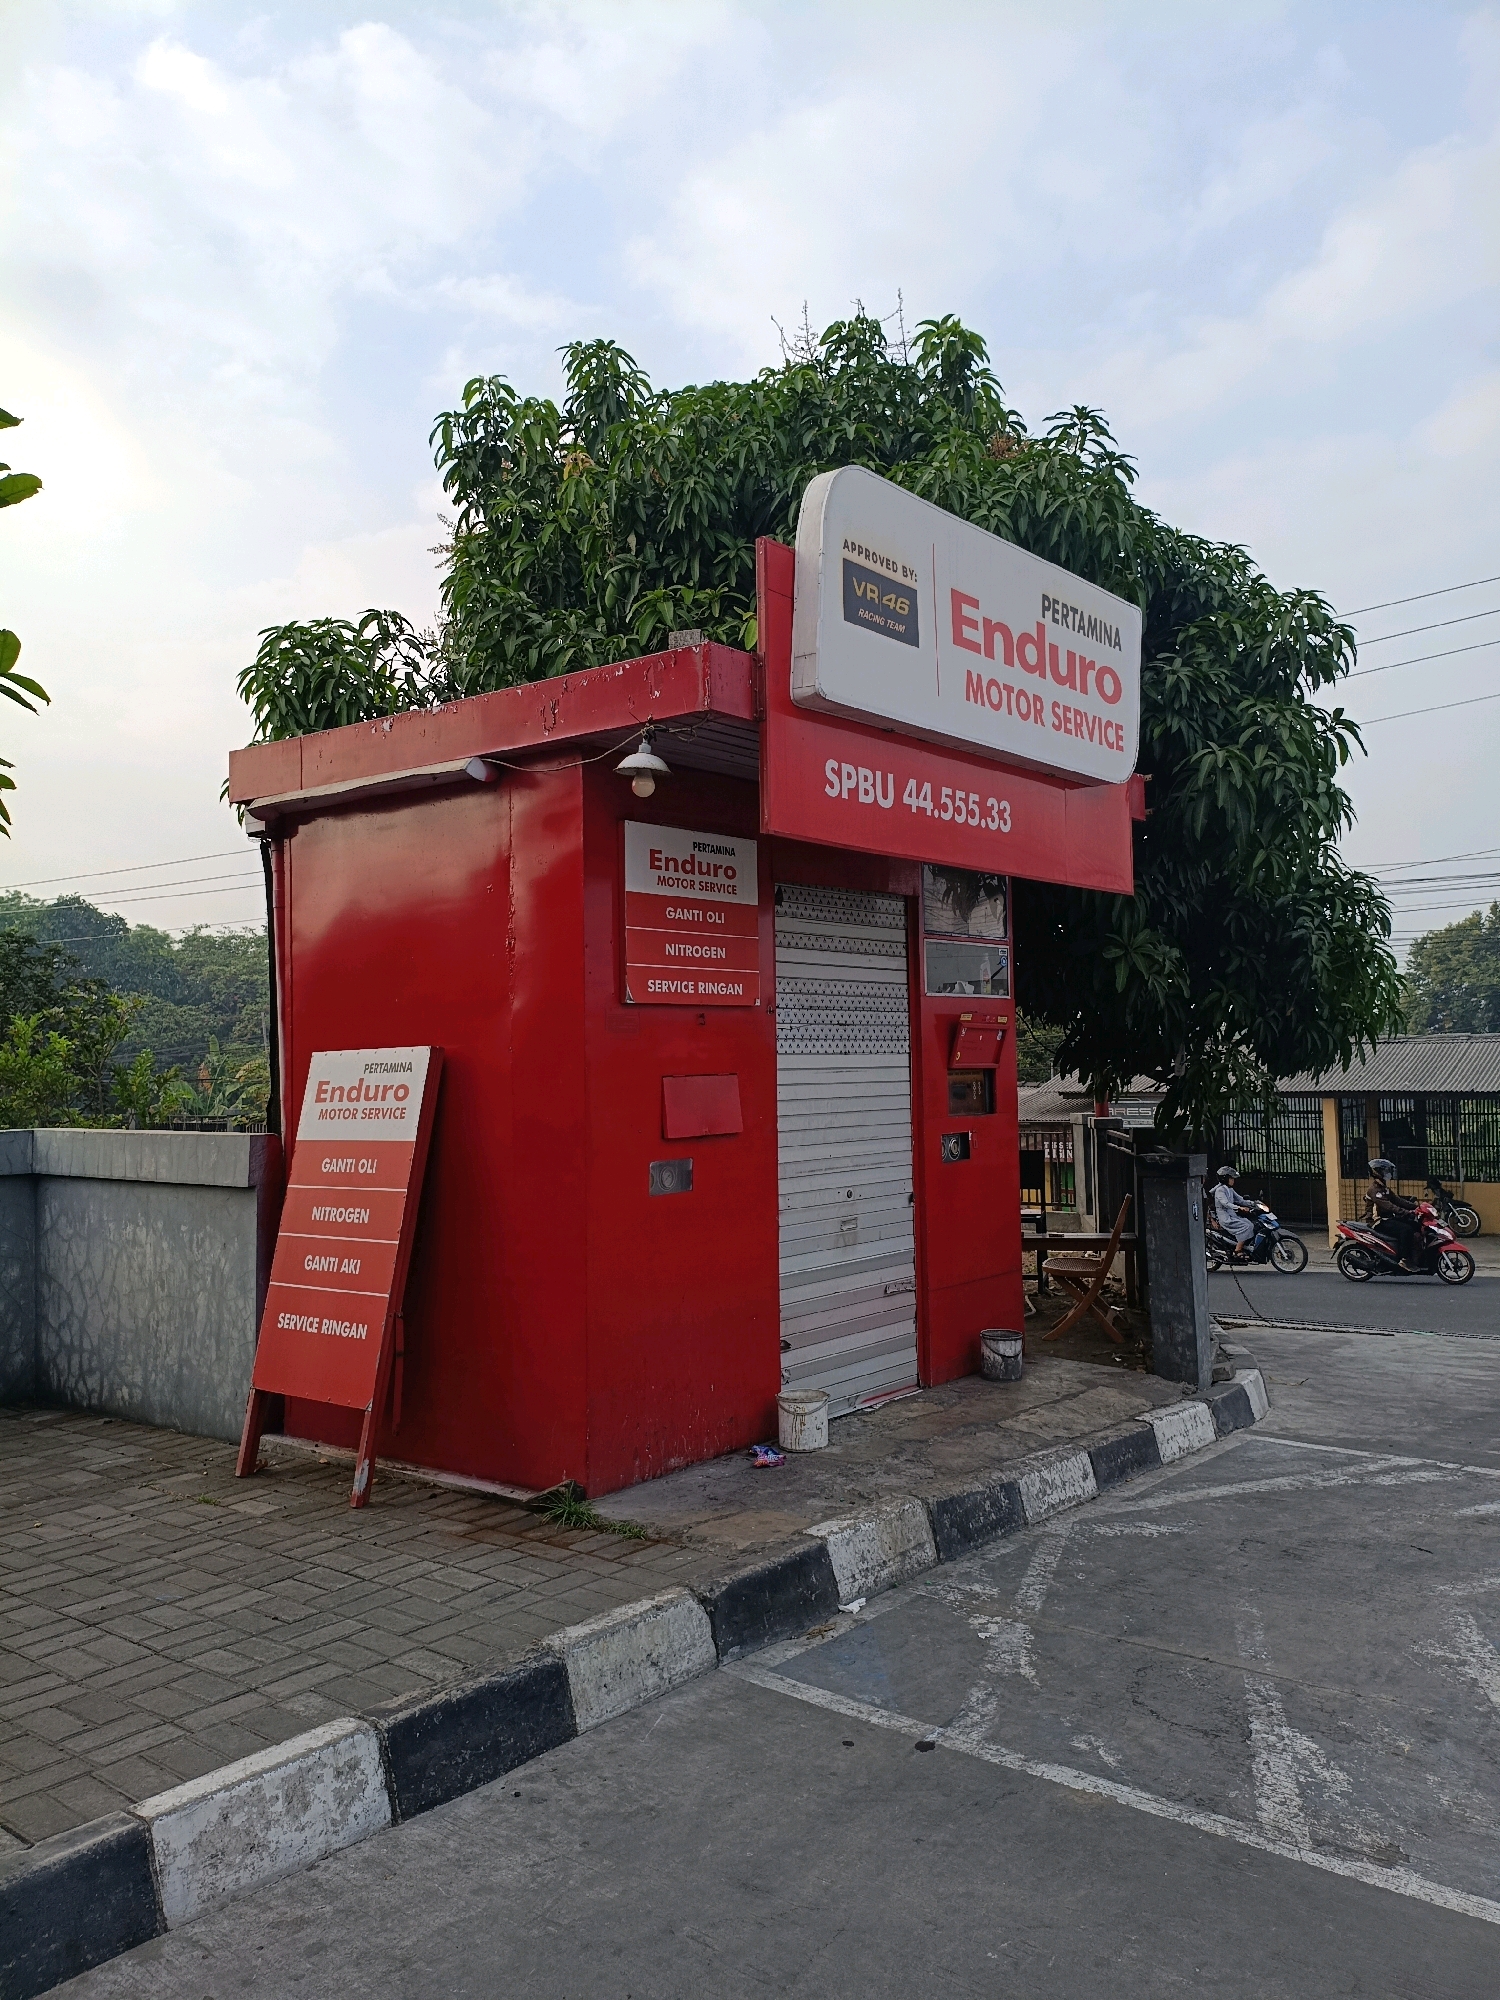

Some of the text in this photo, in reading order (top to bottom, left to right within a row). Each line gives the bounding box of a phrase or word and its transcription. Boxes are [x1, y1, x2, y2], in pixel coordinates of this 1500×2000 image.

[843, 539, 917, 582] APPROVED BY:
[858, 608, 906, 633] RACING TEAM
[1042, 593, 1122, 652] PERTAMINA
[951, 588, 1122, 705] Enduro
[965, 670, 1124, 752] MOTOR SERVICE
[825, 758, 1012, 833] SPBU 44.555.33
[693, 841, 736, 857] PERTAMINA
[650, 849, 737, 880] Enduro
[657, 875, 737, 895] MOTOR SERVICE
[666, 907, 725, 924] GANTI OLI
[666, 944, 726, 959] NITROGEN
[648, 980, 743, 995] SERVICE RINGAN
[364, 1062, 413, 1074] PERTAMINA
[315, 1078, 410, 1103] Enduro
[318, 1107, 406, 1121] MOTOR SERVICE
[322, 1158, 377, 1174] GANTI OLI
[312, 1206, 369, 1224] NITROGEN
[305, 1255, 361, 1275] GANTI AKI
[278, 1312, 367, 1340] SERVICE RINGAN
